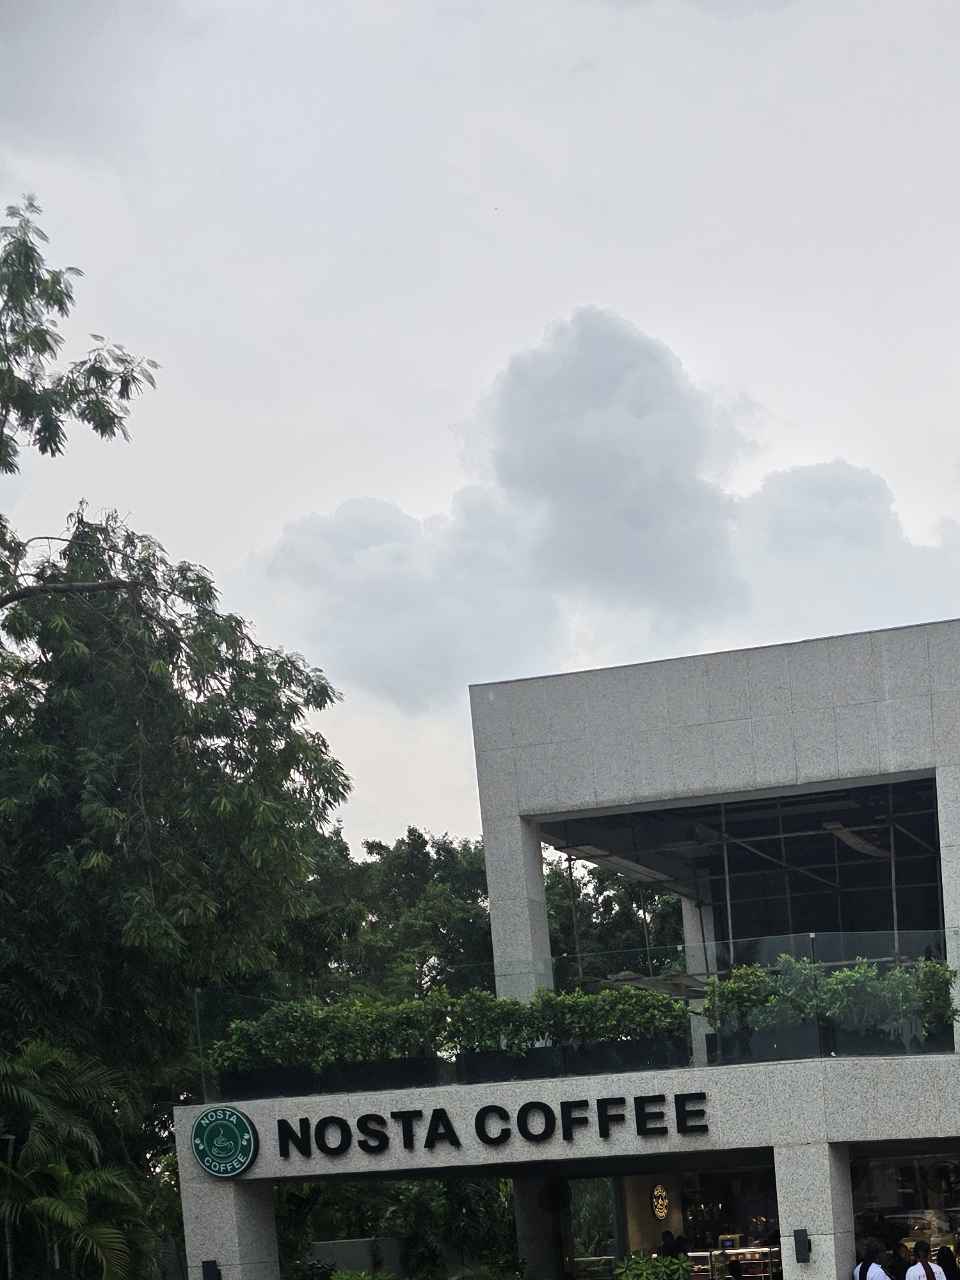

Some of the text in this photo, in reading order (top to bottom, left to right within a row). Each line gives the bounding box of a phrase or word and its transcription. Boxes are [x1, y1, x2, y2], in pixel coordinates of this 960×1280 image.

[200, 1110, 238, 1127] NOSTA
[277, 1092, 709, 1158] NOSTA COFFEE
[204, 1153, 247, 1172] COFFEE
